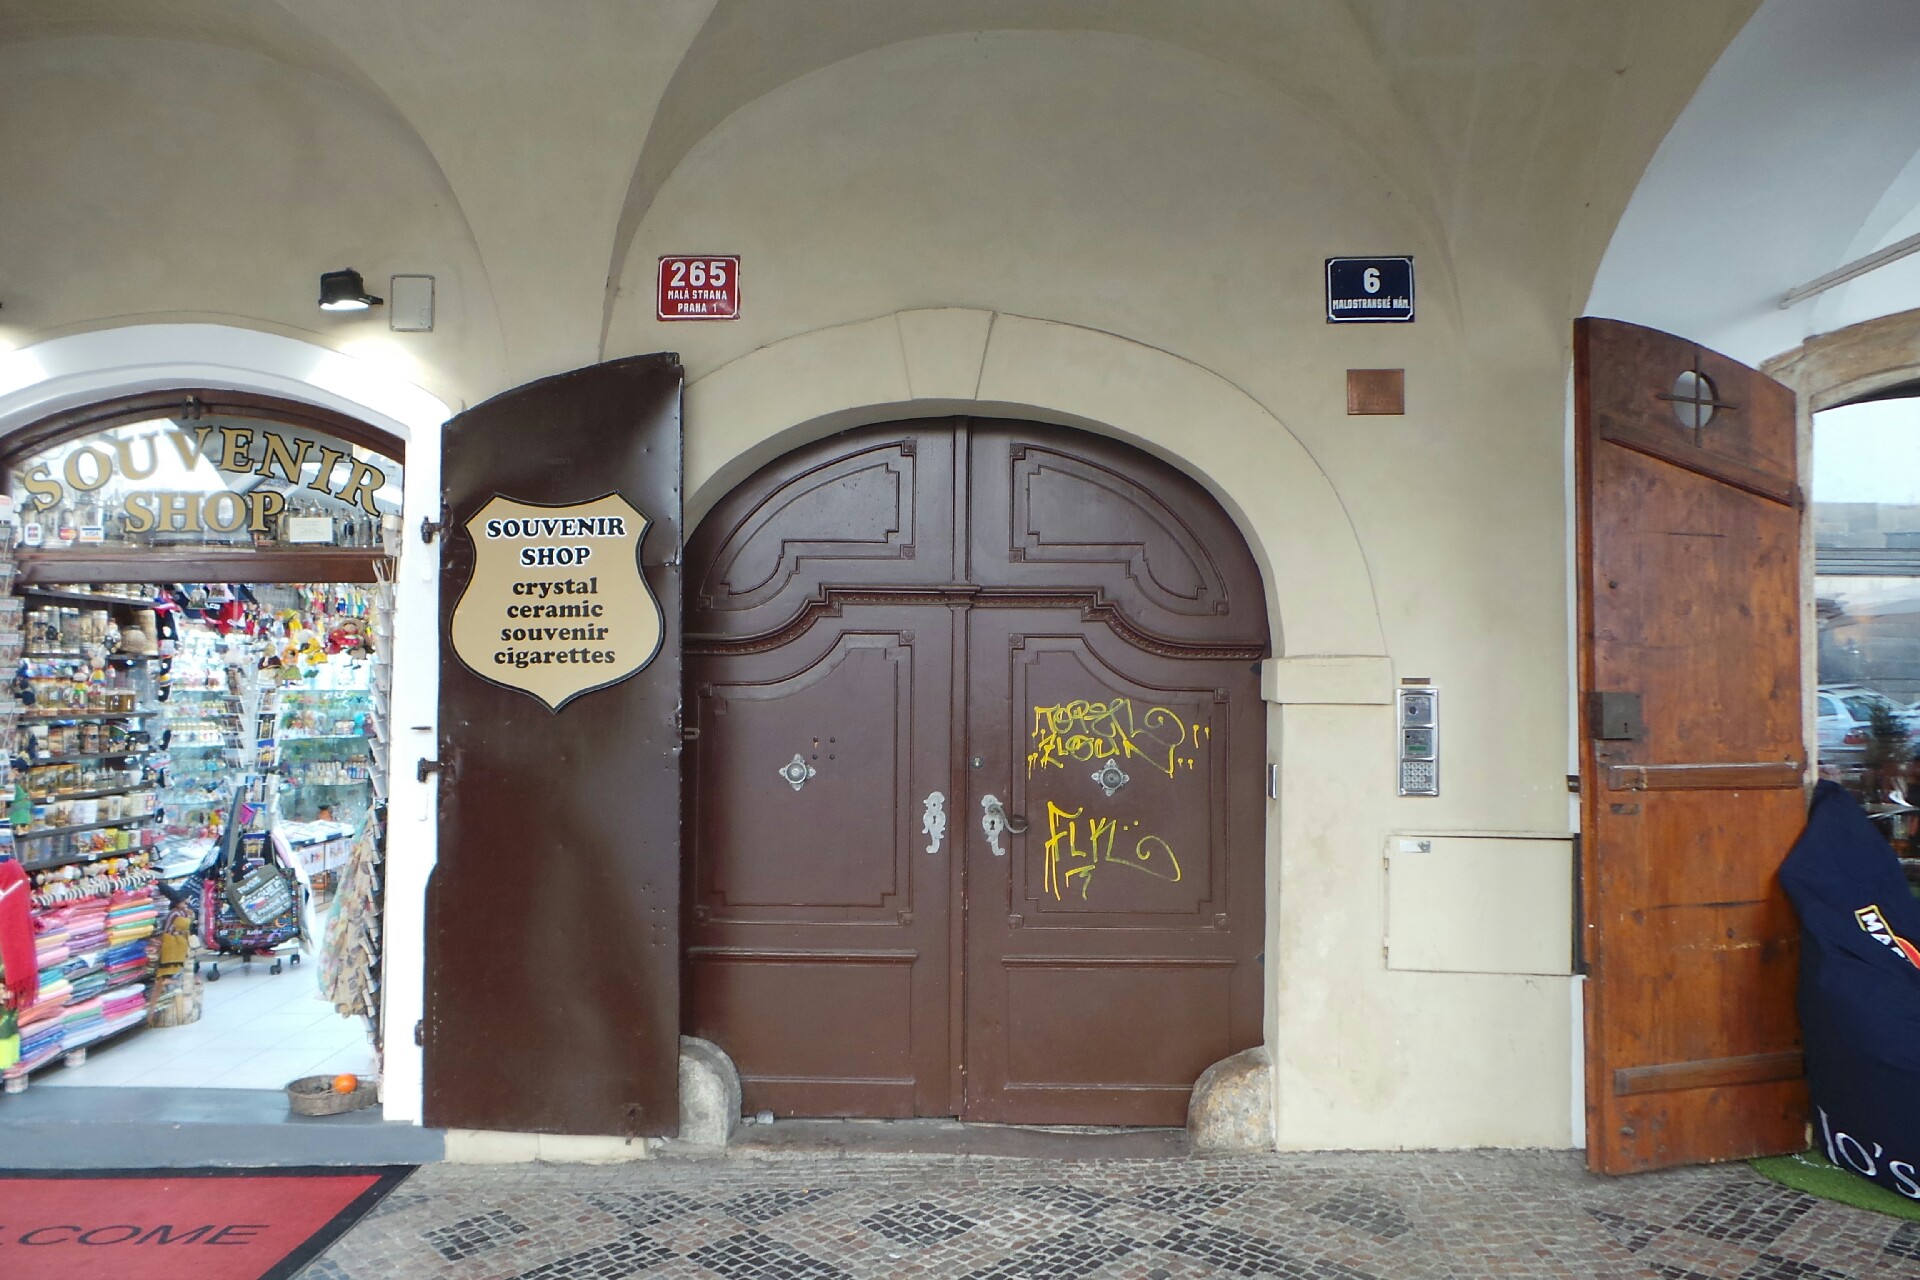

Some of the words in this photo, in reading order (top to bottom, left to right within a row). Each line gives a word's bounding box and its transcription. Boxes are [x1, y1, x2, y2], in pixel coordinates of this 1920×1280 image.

[671, 262, 727, 286] 265
[1363, 267, 1380, 293] 6
[668, 288, 689, 300] MALÁ
[692, 290, 727, 300] STRANA
[1332, 296, 1391, 310] MALOSTRANSKÉ
[677, 303, 706, 312] PRAHA
[712, 303, 718, 312] 1
[23, 425, 386, 517] SOUVENIR
[124, 490, 286, 533] SHOP
[486, 517, 626, 538] SOUVENIR
[520, 547, 591, 567] SHOP
[512, 577, 598, 598] crystal
[507, 600, 604, 618] ceramic
[501, 623, 609, 641] souvenir
[493, 647, 616, 669] cigarettes
[0, 1224, 270, 1246] COME
